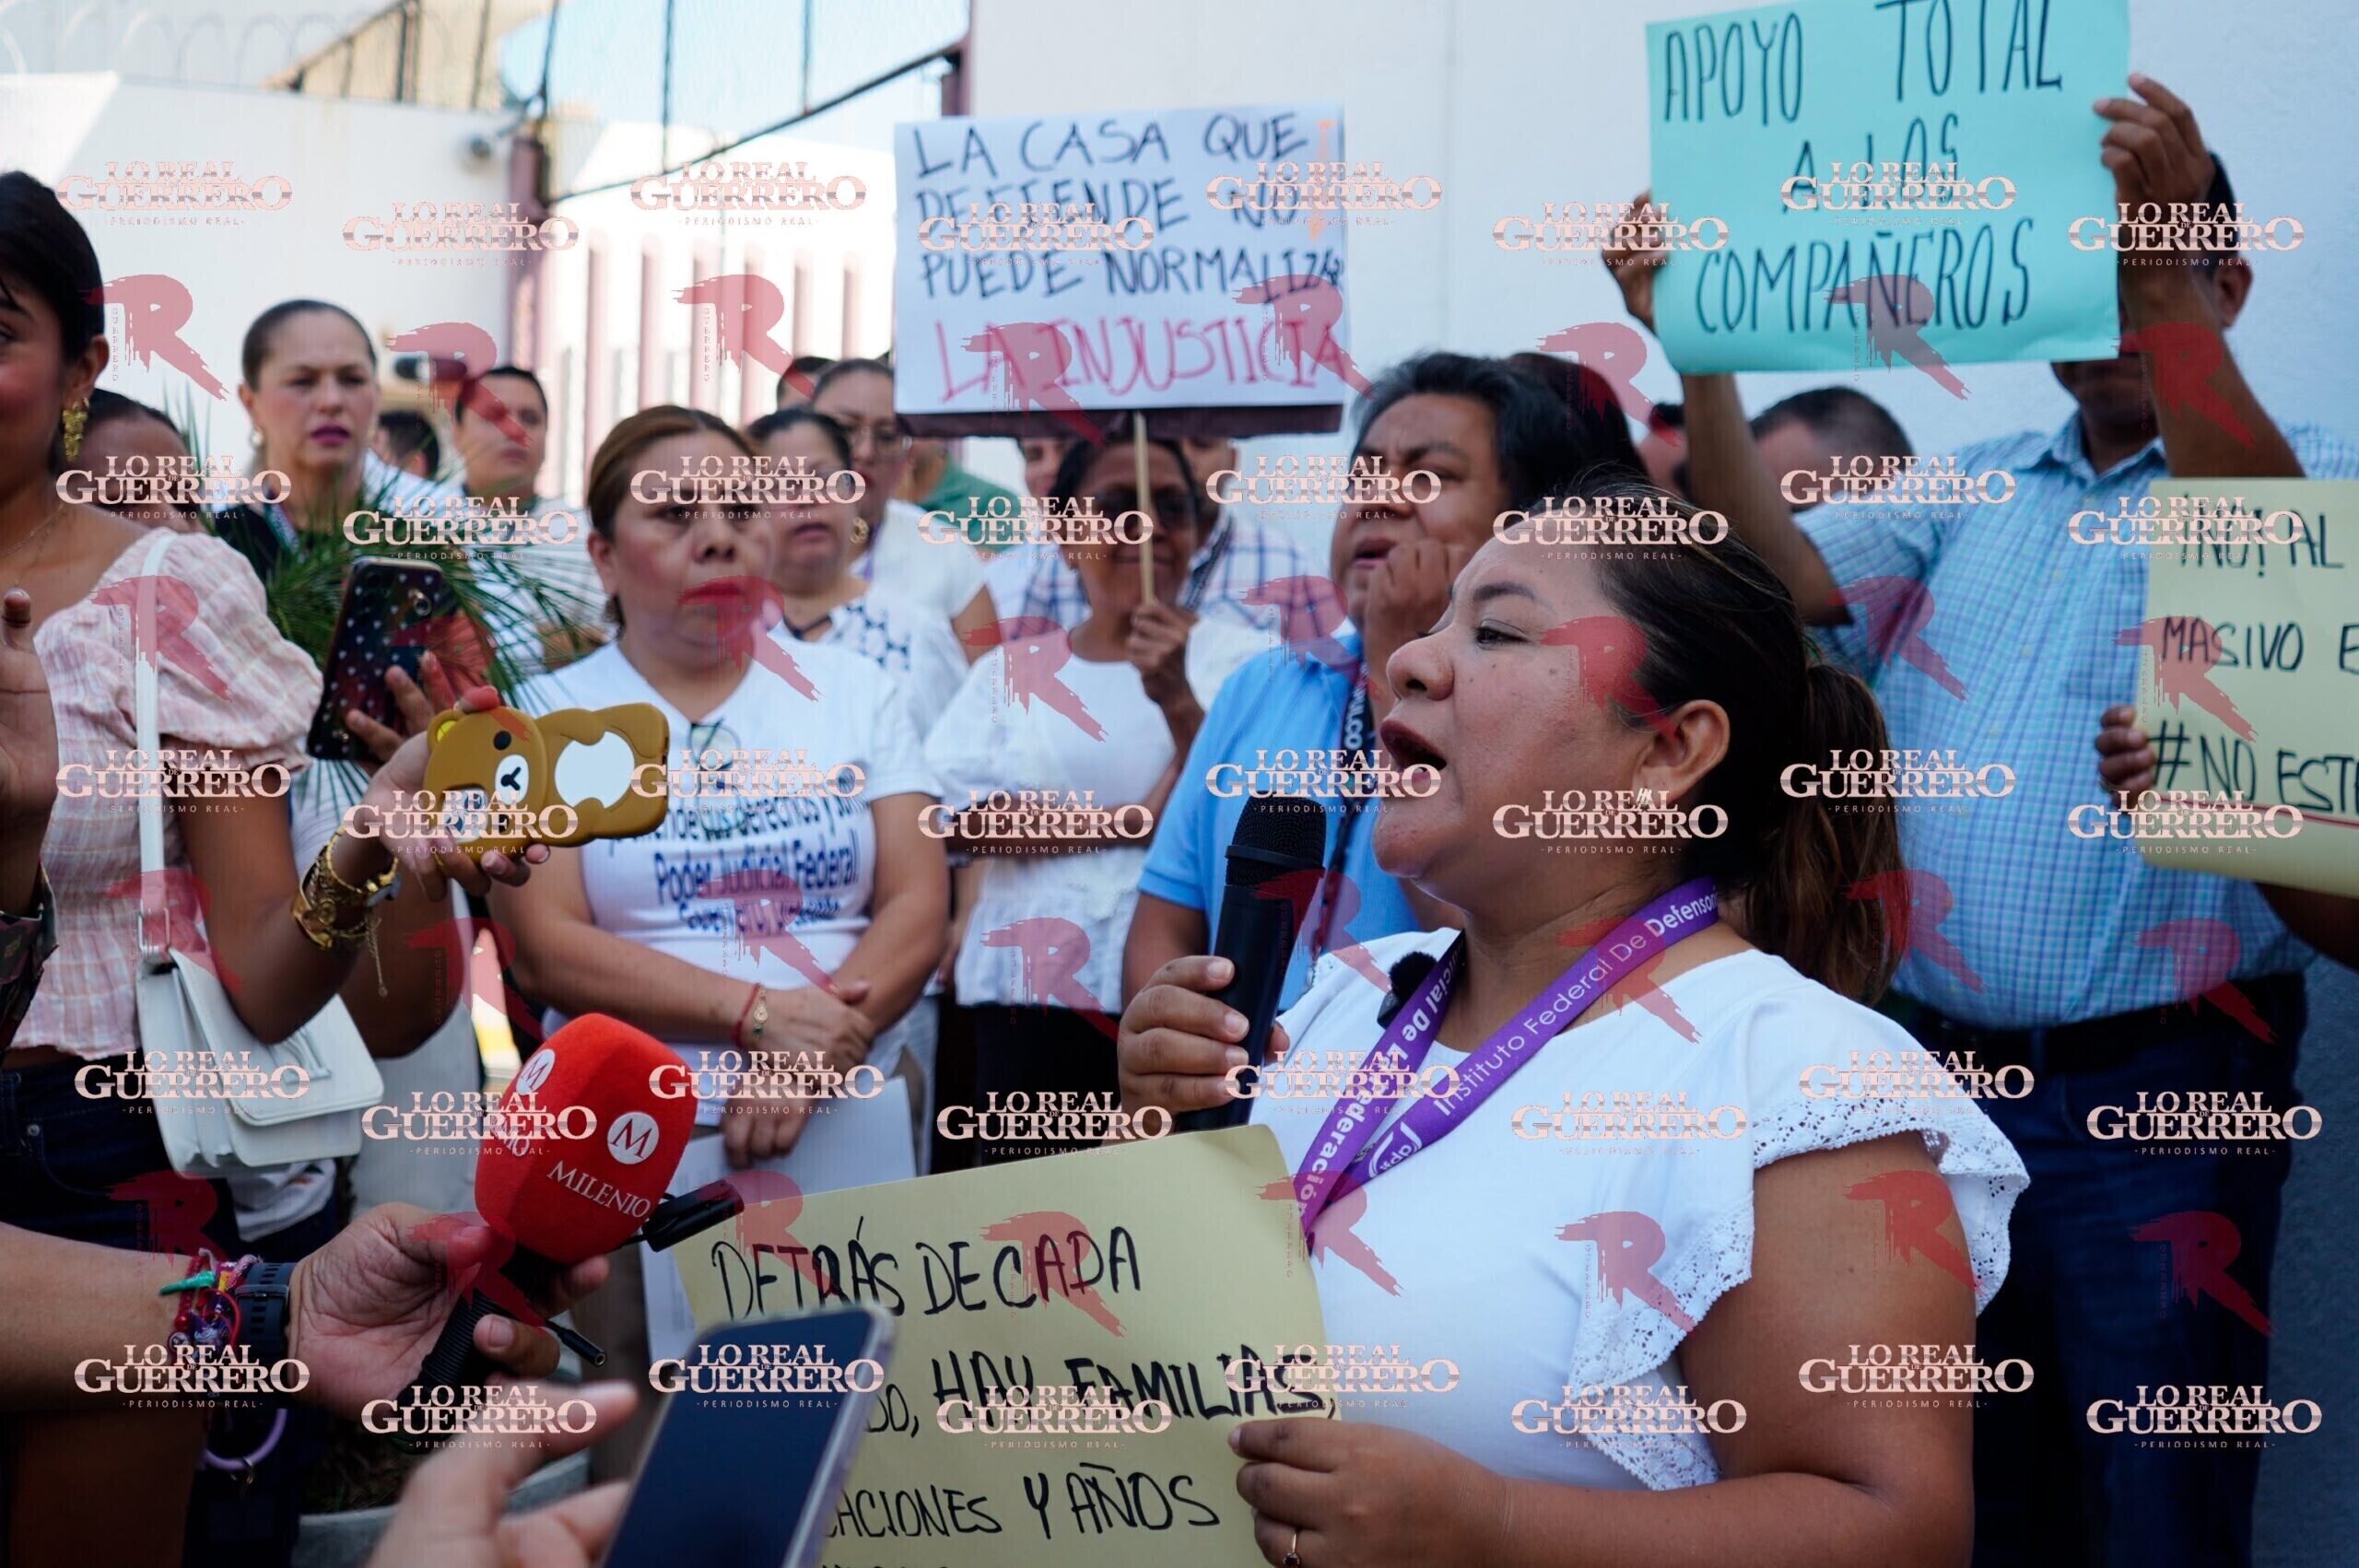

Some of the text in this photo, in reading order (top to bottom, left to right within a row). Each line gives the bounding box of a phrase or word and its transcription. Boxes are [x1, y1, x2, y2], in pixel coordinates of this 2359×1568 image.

[1663, 13, 1803, 127] APOYO
[913, 111, 1309, 179] LA CASA QUE
[921, 248, 1082, 298] PUEDE
[1696, 216, 2034, 334] COMPAÑEROS
[935, 315, 1346, 405] LA INJUSTICIA
[2162, 614, 2306, 673] MASIVO
[2276, 747, 2359, 814] EST
[653, 828, 860, 905] Poder Judicial Federal
[1401, 1007, 1432, 1042] De
[1433, 1035, 1526, 1117] Instituto
[1523, 957, 1614, 1036] Federal
[1609, 934, 1648, 963] De
[520, 1058, 550, 1091] M
[610, 1117, 653, 1159] M
[546, 1160, 651, 1219] MILENIO
[915, 1240, 988, 1316] DE
[992, 1225, 1142, 1308] CADA
[932, 1350, 1034, 1427] HAY
[825, 1461, 1221, 1539] ACIONES Y AÑOS
